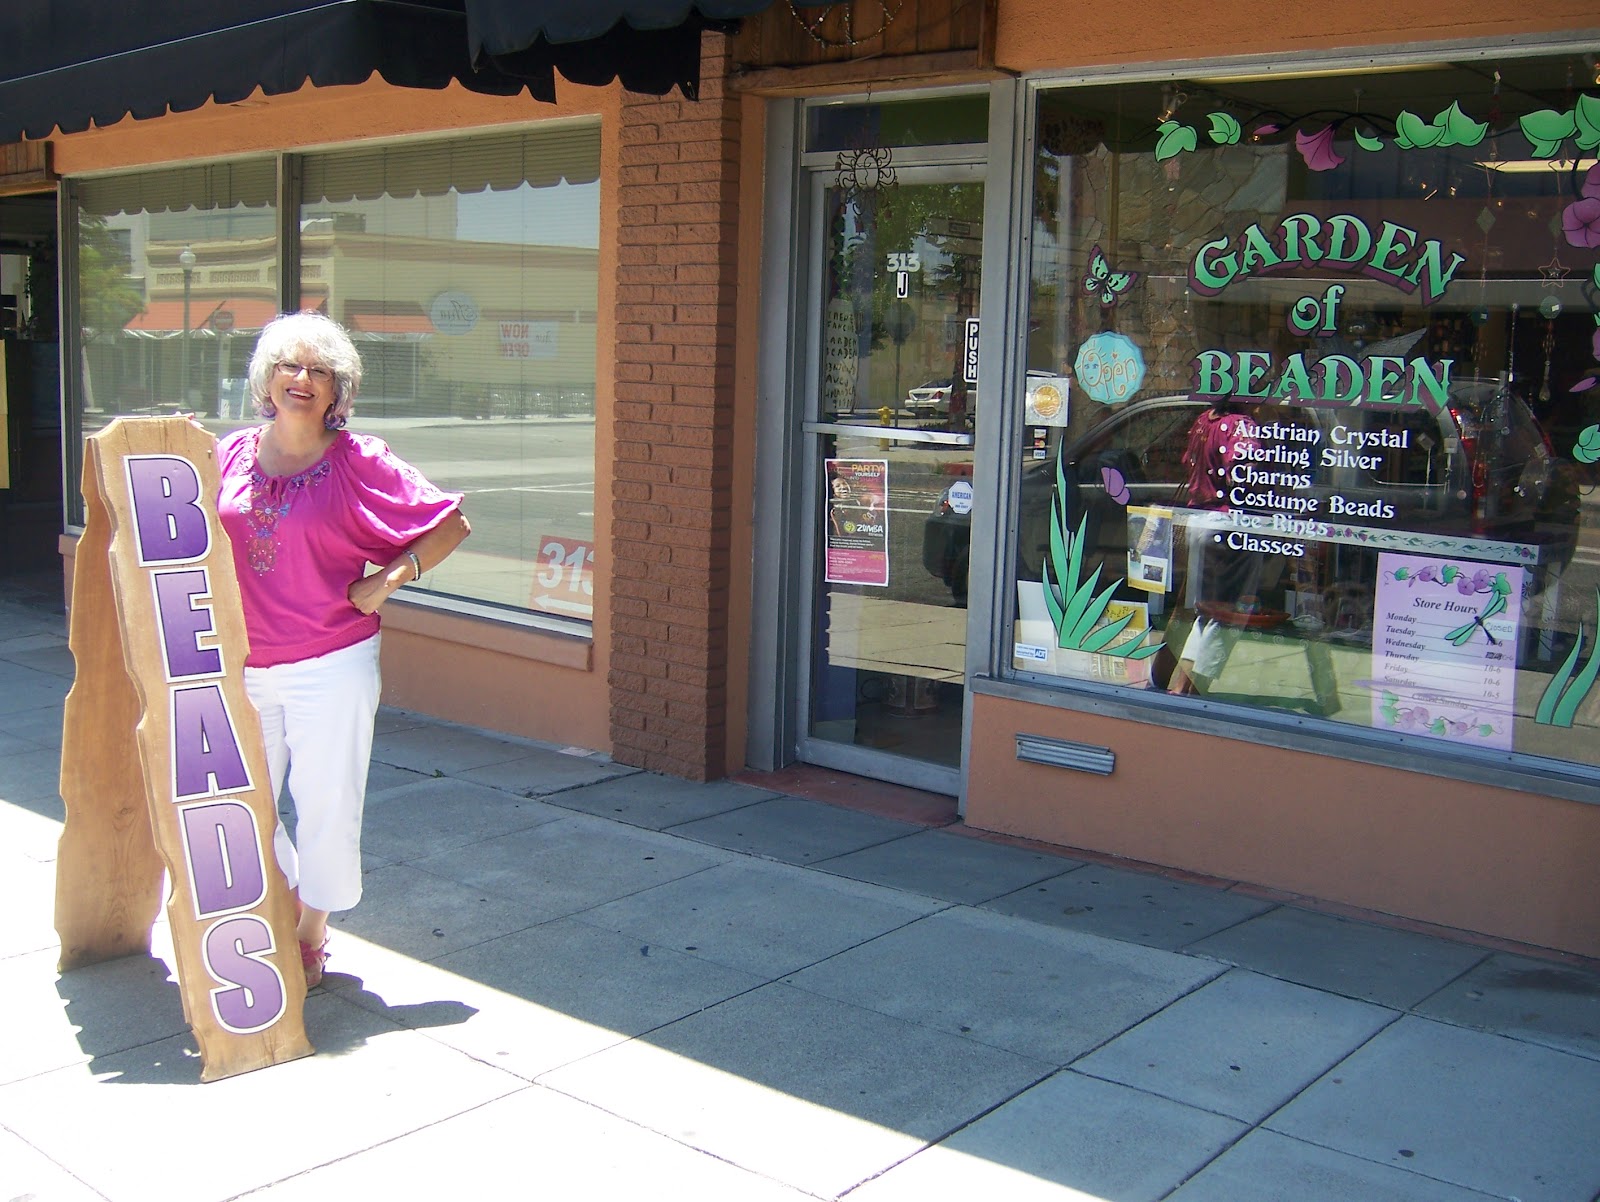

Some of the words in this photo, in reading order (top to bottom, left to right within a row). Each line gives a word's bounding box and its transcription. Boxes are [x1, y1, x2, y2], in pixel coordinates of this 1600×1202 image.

[887, 253, 920, 272] 313
[1188, 213, 1466, 306] GARDEN
[898, 273, 907, 296] J
[1287, 285, 1345, 337] of
[968, 323, 979, 378] PUSH
[1081, 348, 1137, 400] Open
[1189, 350, 1454, 416] BEADEN
[1233, 420, 1320, 445] Austrian
[1330, 425, 1408, 449] Crystal
[852, 464, 882, 473] PARTY
[1232, 442, 1310, 469] Sterling
[1320, 448, 1382, 470] Silver
[1231, 464, 1312, 490] Charms
[1229, 487, 1319, 513] Costume
[1329, 495, 1395, 519] Beads
[856, 524, 883, 533] ZUMBA
[1228, 508, 1262, 529] Toe
[1272, 513, 1330, 537] Rings
[1226, 531, 1305, 557] Classes
[1386, 612, 1417, 624] Monday
[1413, 597, 1442, 610] Store
[1444, 600, 1479, 615] Hours
[1385, 637, 1426, 650] Wednesday
[1386, 625, 1416, 637] Tuesday
[1385, 650, 1420, 663] Thursday
[1484, 664, 1501, 673] 10-6
[1384, 663, 1409, 674] Friday
[1483, 677, 1500, 687] 10-6
[1384, 675, 1417, 687] Saturday
[123, 453, 288, 1034] BEADS
